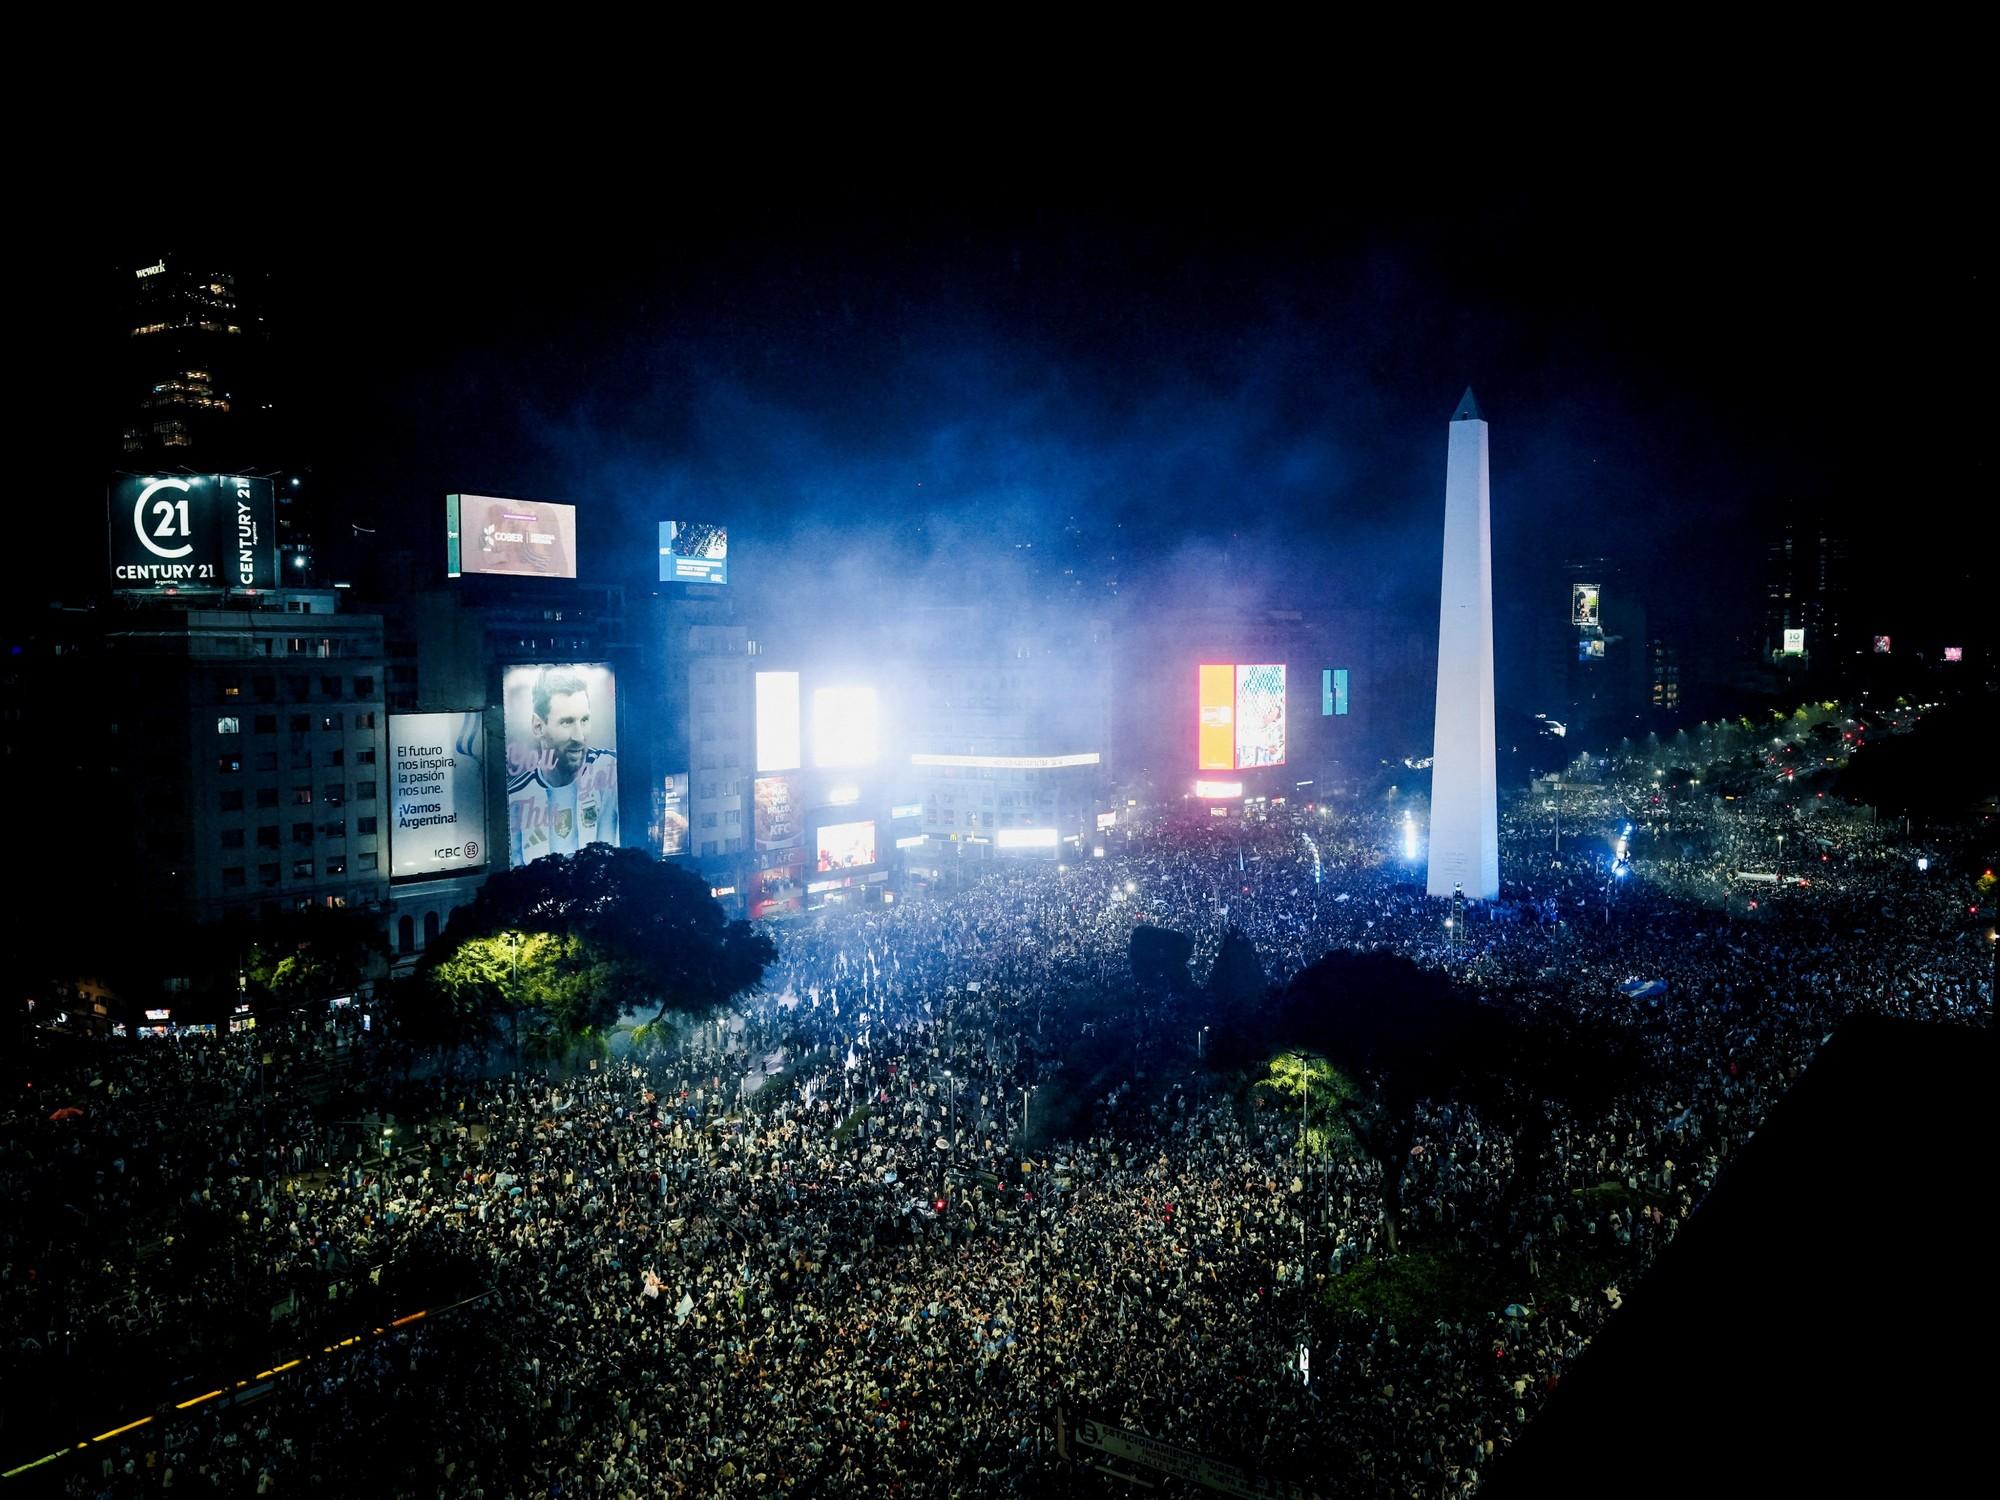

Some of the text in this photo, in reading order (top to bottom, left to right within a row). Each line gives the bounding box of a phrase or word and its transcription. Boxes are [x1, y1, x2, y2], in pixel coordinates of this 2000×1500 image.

[236, 481, 254, 585] CENTURY 21
[115, 564, 214, 580] CENTURY 21
[397, 745, 443, 758] El futuro
[398, 757, 457, 772] nos inspira,
[398, 771, 445, 785] la pasión
[398, 786, 444, 797] nos une.
[399, 803, 441, 818] ¡Vamos
[399, 813, 457, 829] Argentina!
[434, 846, 461, 859] ICBC
